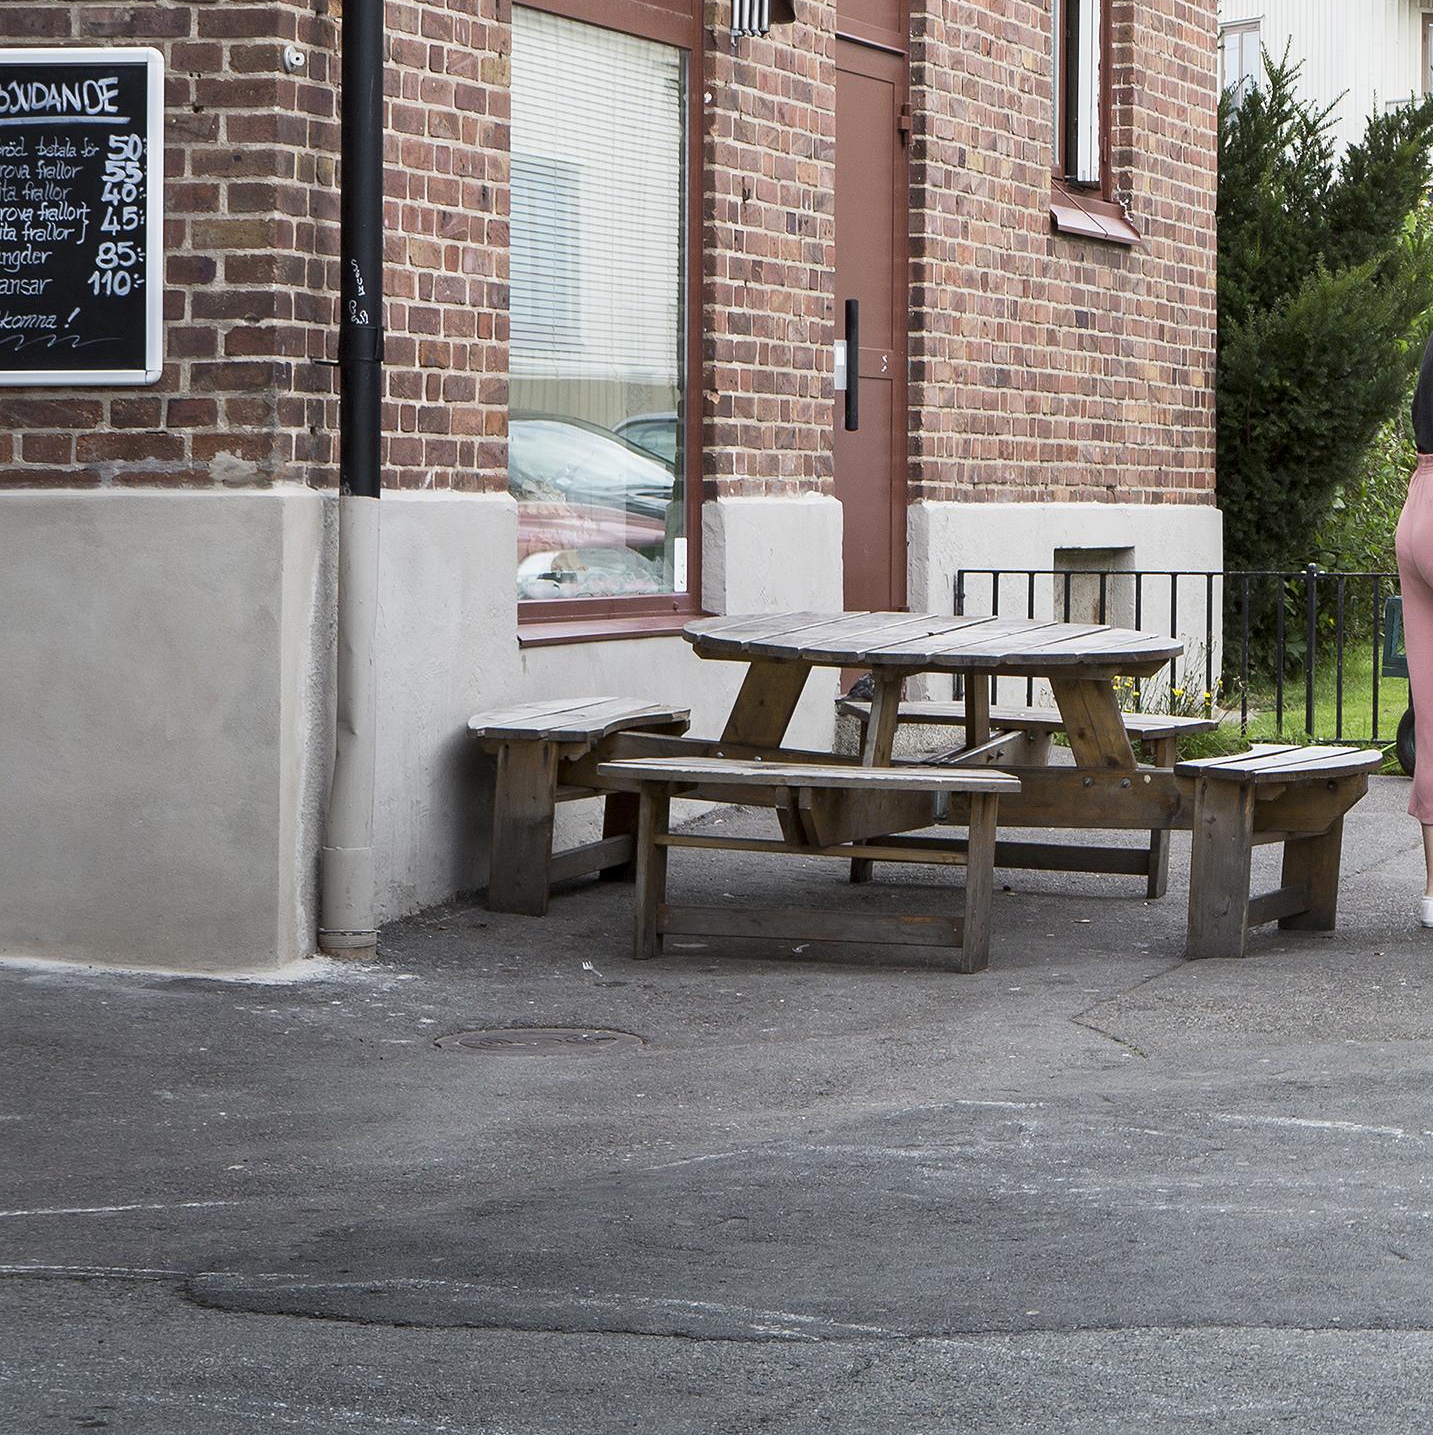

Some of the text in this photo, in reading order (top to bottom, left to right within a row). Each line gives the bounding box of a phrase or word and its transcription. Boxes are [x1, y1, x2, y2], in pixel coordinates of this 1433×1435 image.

[36, 136, 99, 157] betala för
[36, 160, 83, 179] frallor
[22, 181, 72, 201] frallor
[0, 244, 52, 272] ngder
